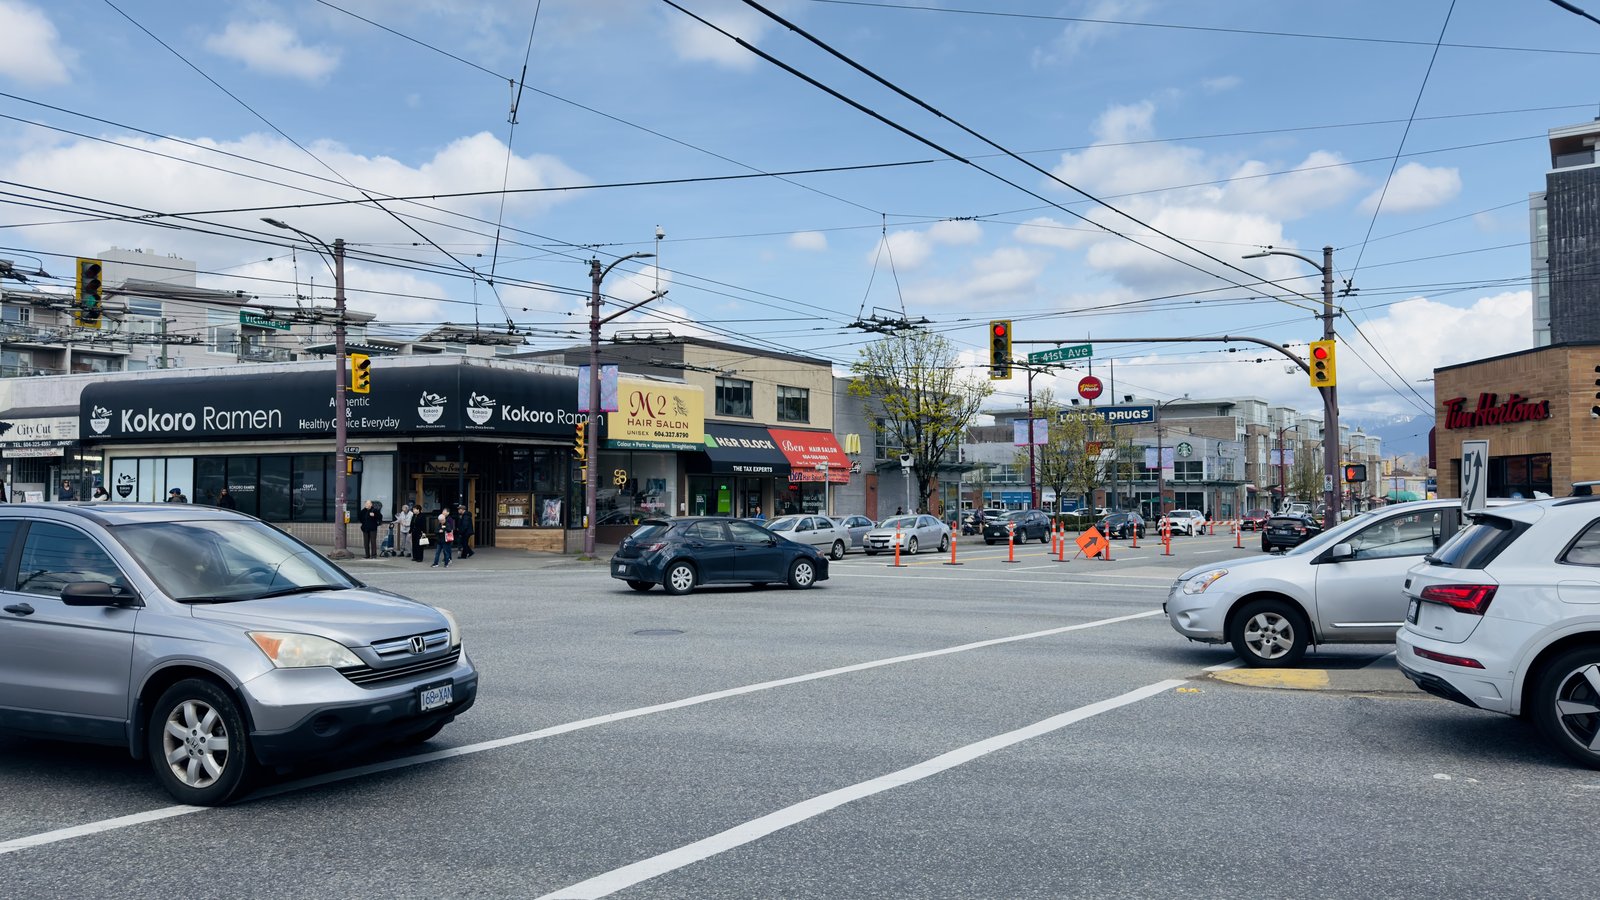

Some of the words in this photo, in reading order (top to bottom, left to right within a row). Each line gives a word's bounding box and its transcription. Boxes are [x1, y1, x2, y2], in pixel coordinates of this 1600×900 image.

[1032, 354, 1038, 363] E
[1042, 350, 1062, 361] 41st
[1068, 347, 1088, 358] Ave
[346, 408, 352, 418] &
[502, 405, 554, 423] Kokoro
[1060, 412, 1104, 422] LONDON
[1109, 410, 1148, 420] DRUGS
[1443, 396, 1475, 429] Tim
[1474, 392, 1550, 426] Hortons
[121, 408, 196, 432] Kokoro
[203, 406, 282, 430] Ramen
[299, 419, 330, 430] Healthy
[361, 417, 400, 430] Everyday
[628, 418, 652, 426] HAIR
[656, 420, 688, 429] SALON
[17, 424, 34, 438] City
[36, 424, 51, 434] Cut
[716, 437, 738, 448] H&R
[739, 438, 775, 449] BLOCK
[782, 440, 804, 452] Ben
